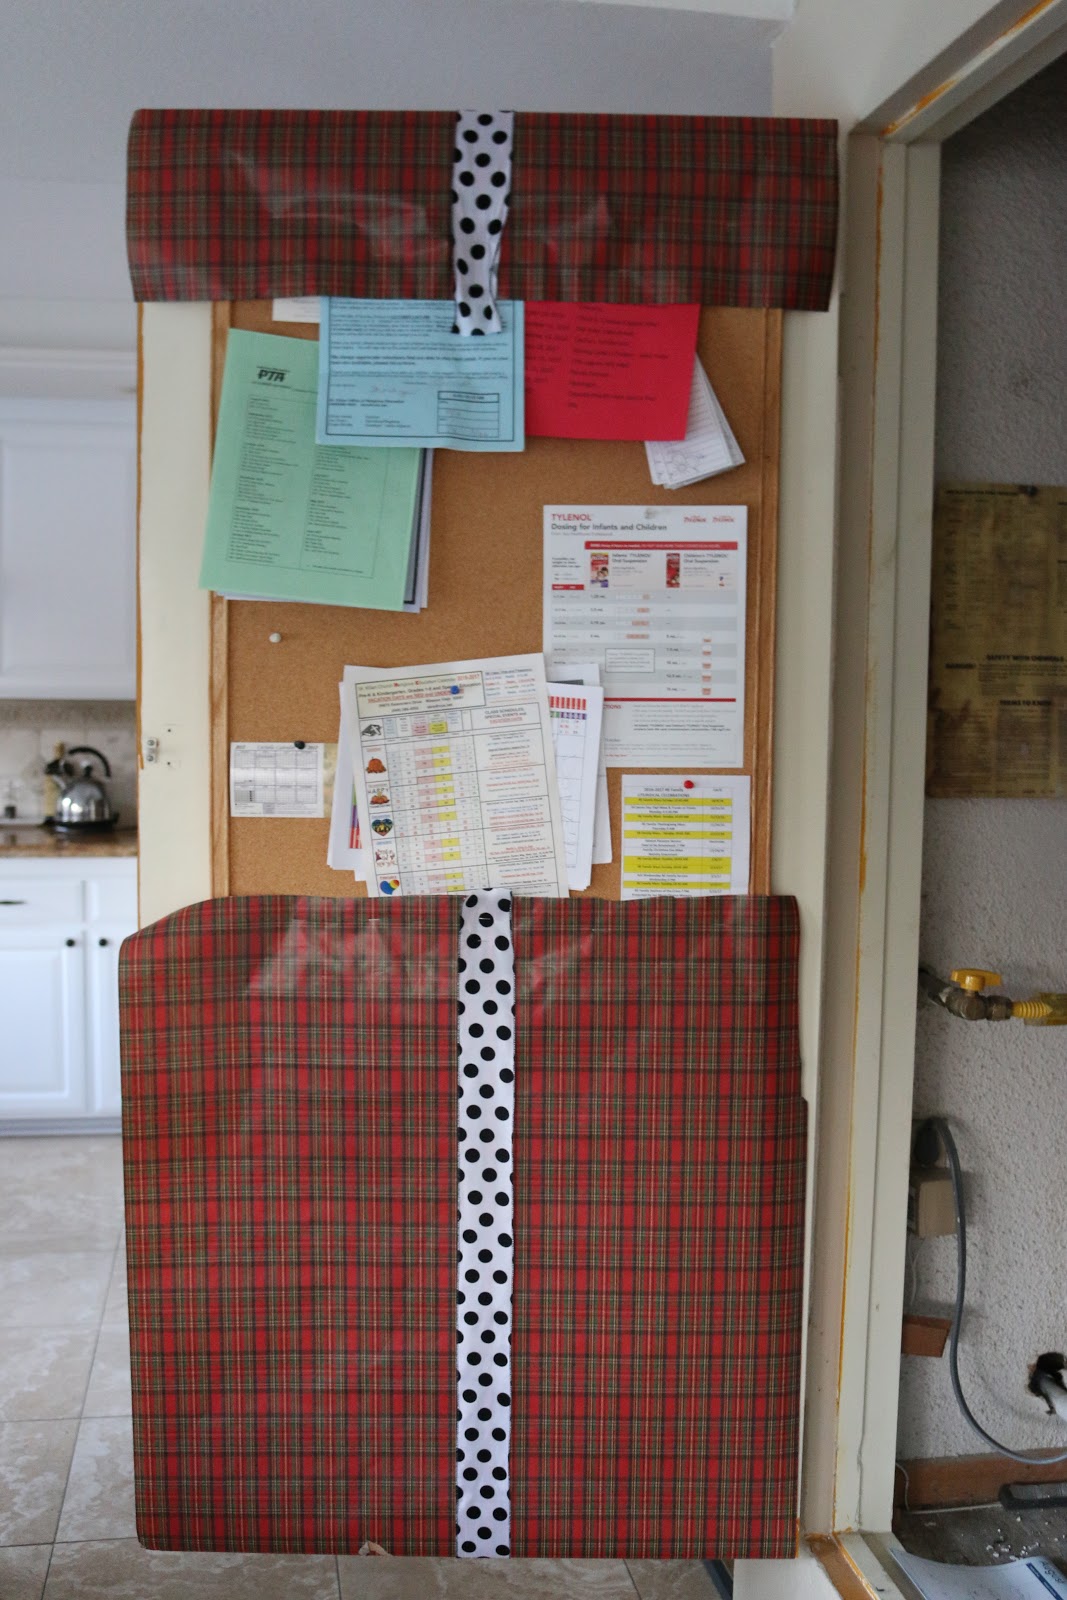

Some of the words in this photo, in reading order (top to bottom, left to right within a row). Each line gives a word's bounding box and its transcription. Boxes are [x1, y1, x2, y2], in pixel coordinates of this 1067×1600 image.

[258, 369, 286, 382] PTA
[551, 513, 592, 521] TYLENOL
[551, 523, 577, 531] Dosing
